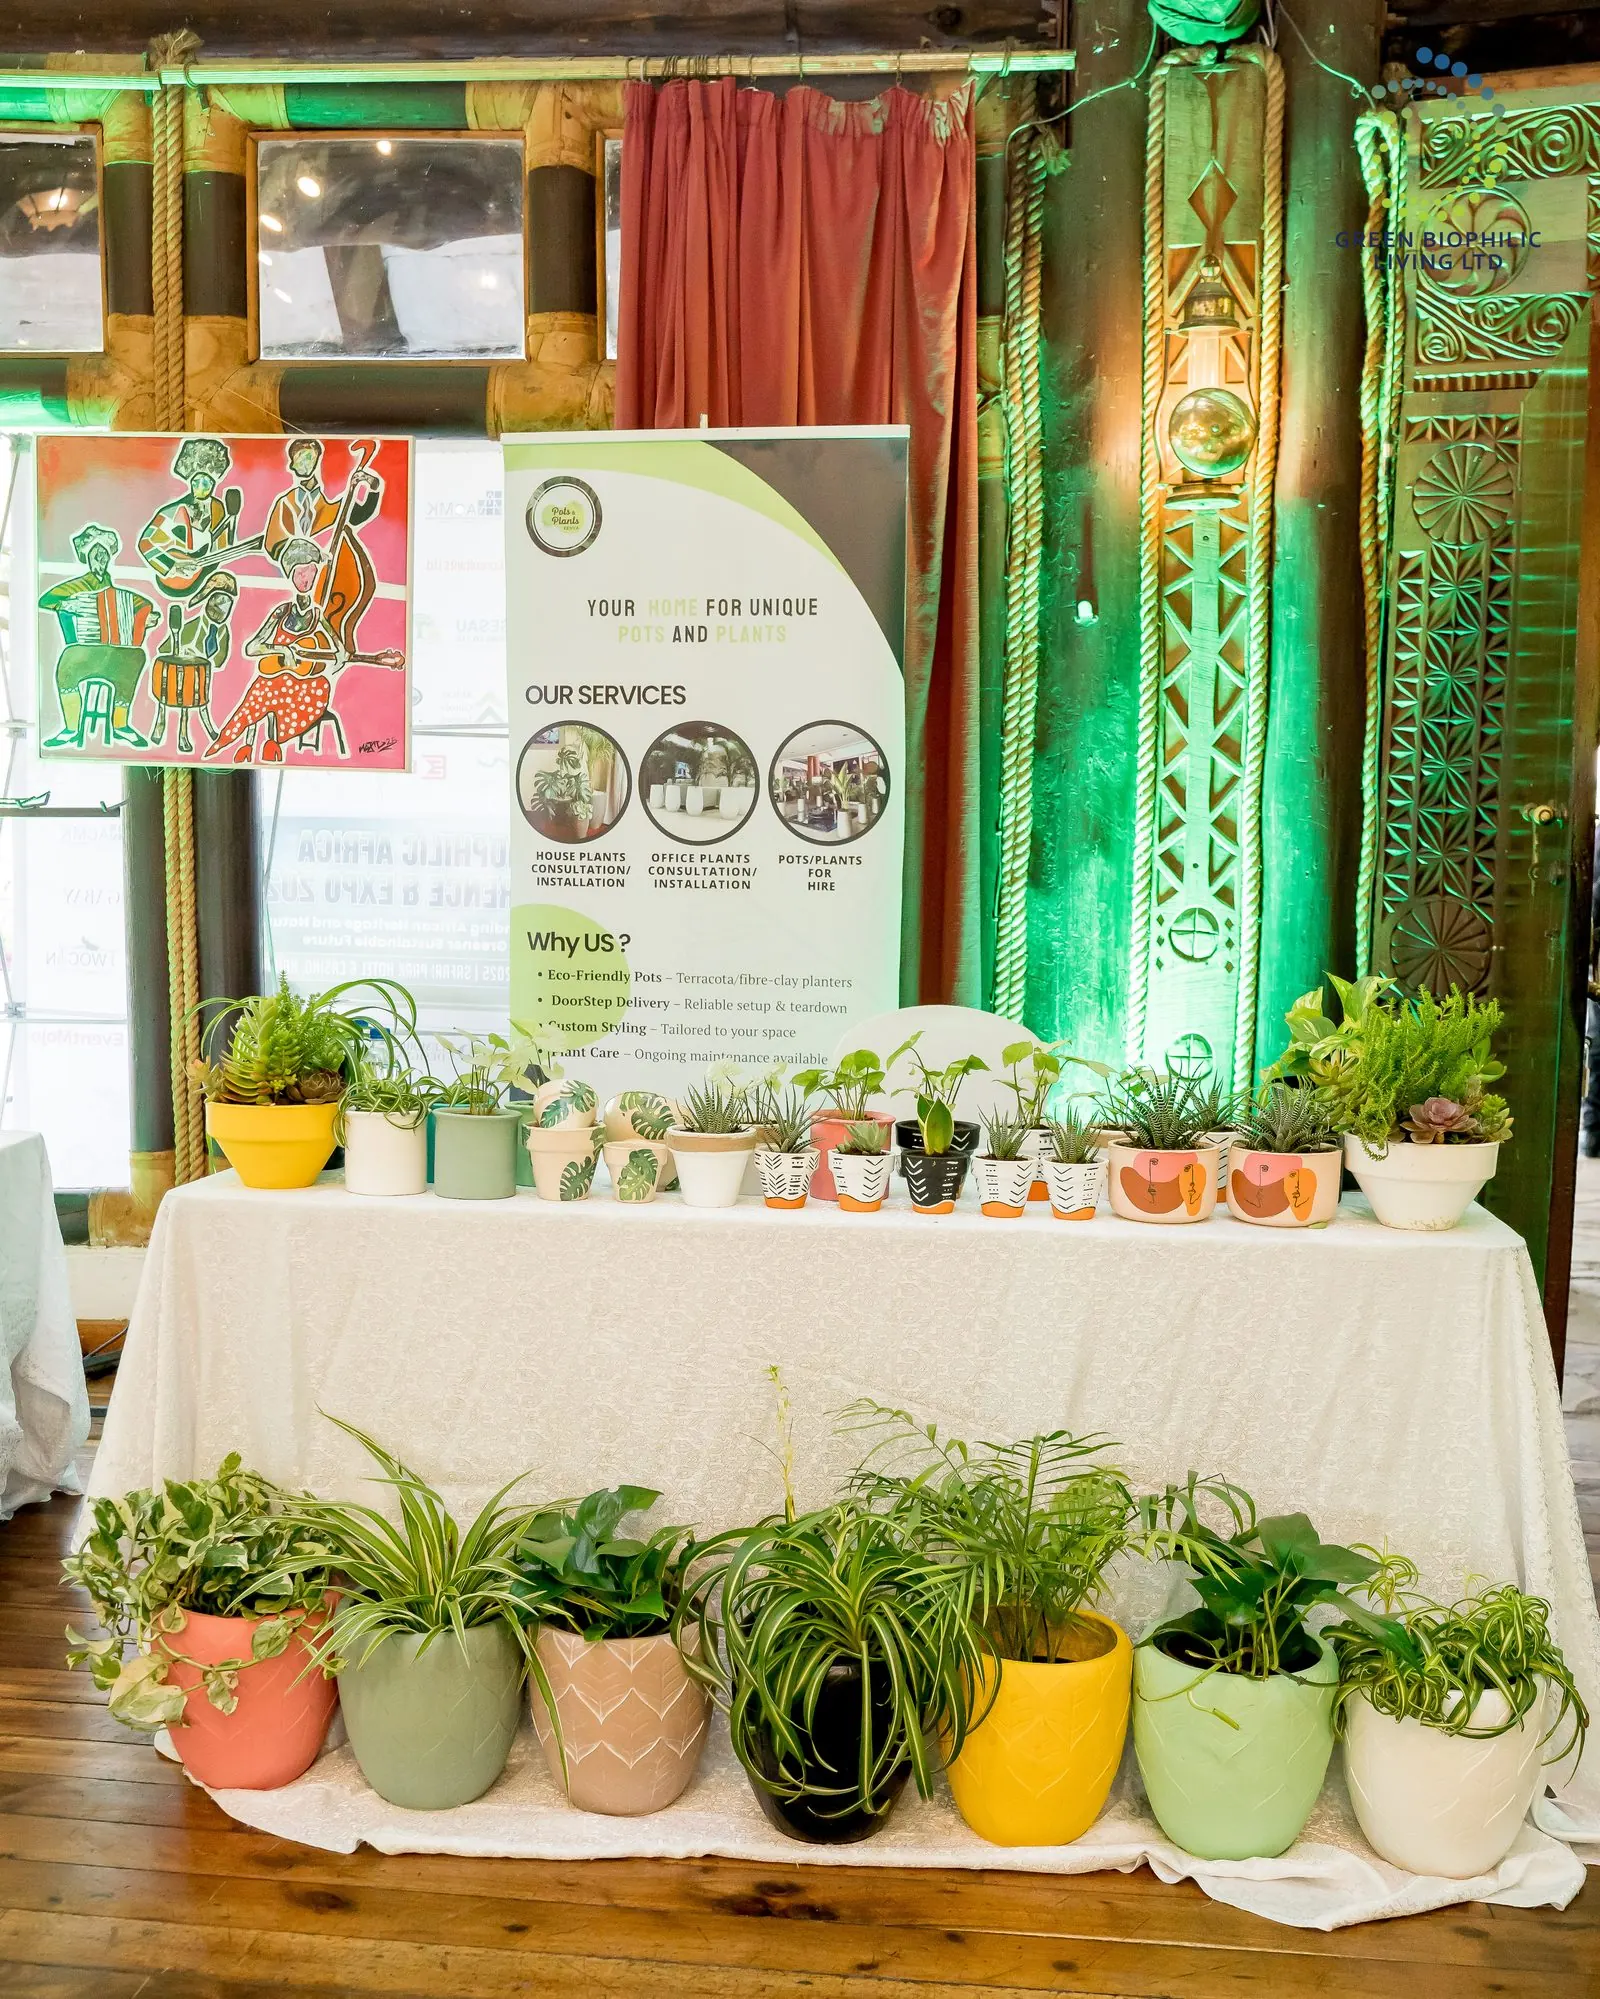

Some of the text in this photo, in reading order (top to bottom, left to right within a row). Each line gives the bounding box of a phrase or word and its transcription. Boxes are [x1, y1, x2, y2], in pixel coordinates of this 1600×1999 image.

[551, 506, 571, 516] Pots
[551, 516, 580, 525] Plants
[588, 598, 818, 617] YOUR HOME FOR UNIQUE
[618, 624, 787, 644] POTS AND PLANTS
[525, 684, 687, 705] OUR SERVICES
[536, 851, 626, 862] HOUSE PLANTS
[651, 853, 750, 864] OFFICE PLANTS
[778, 855, 863, 865] POTS/PLANTS
[531, 863, 631, 876] CONSULTATION/
[648, 866, 758, 877] CONSULTATION/
[808, 868, 832, 878] FOR
[536, 877, 625, 888] INSTALLATION
[654, 879, 751, 890] INSTALLATION
[808, 881, 836, 891] HIRE
[527, 931, 580, 958] Why
[584, 933, 614, 953] US
[548, 970, 631, 984] Eco-Friendly
[634, 971, 662, 983] Pots
[676, 973, 799, 989] Terracota/fibre-clay
[802, 975, 853, 990] planters
[551, 995, 613, 1009] DoorStep
[616, 996, 670, 1011] Delivery
[684, 998, 734, 1011] Reliable
[737, 1001, 771, 1014] setup
[775, 1000, 786, 1012] &
[790, 1001, 848, 1014] teardown
[601, 1022, 647, 1036] Styling
[660, 1024, 711, 1036] Tailored
[715, 1026, 728, 1037] to
[731, 1028, 759, 1039] your
[762, 1029, 797, 1040] space
[551, 1047, 587, 1058] ant
[590, 1047, 620, 1059] Care
[634, 1049, 687, 1063] Ongoing
[773, 1052, 828, 1065] available
